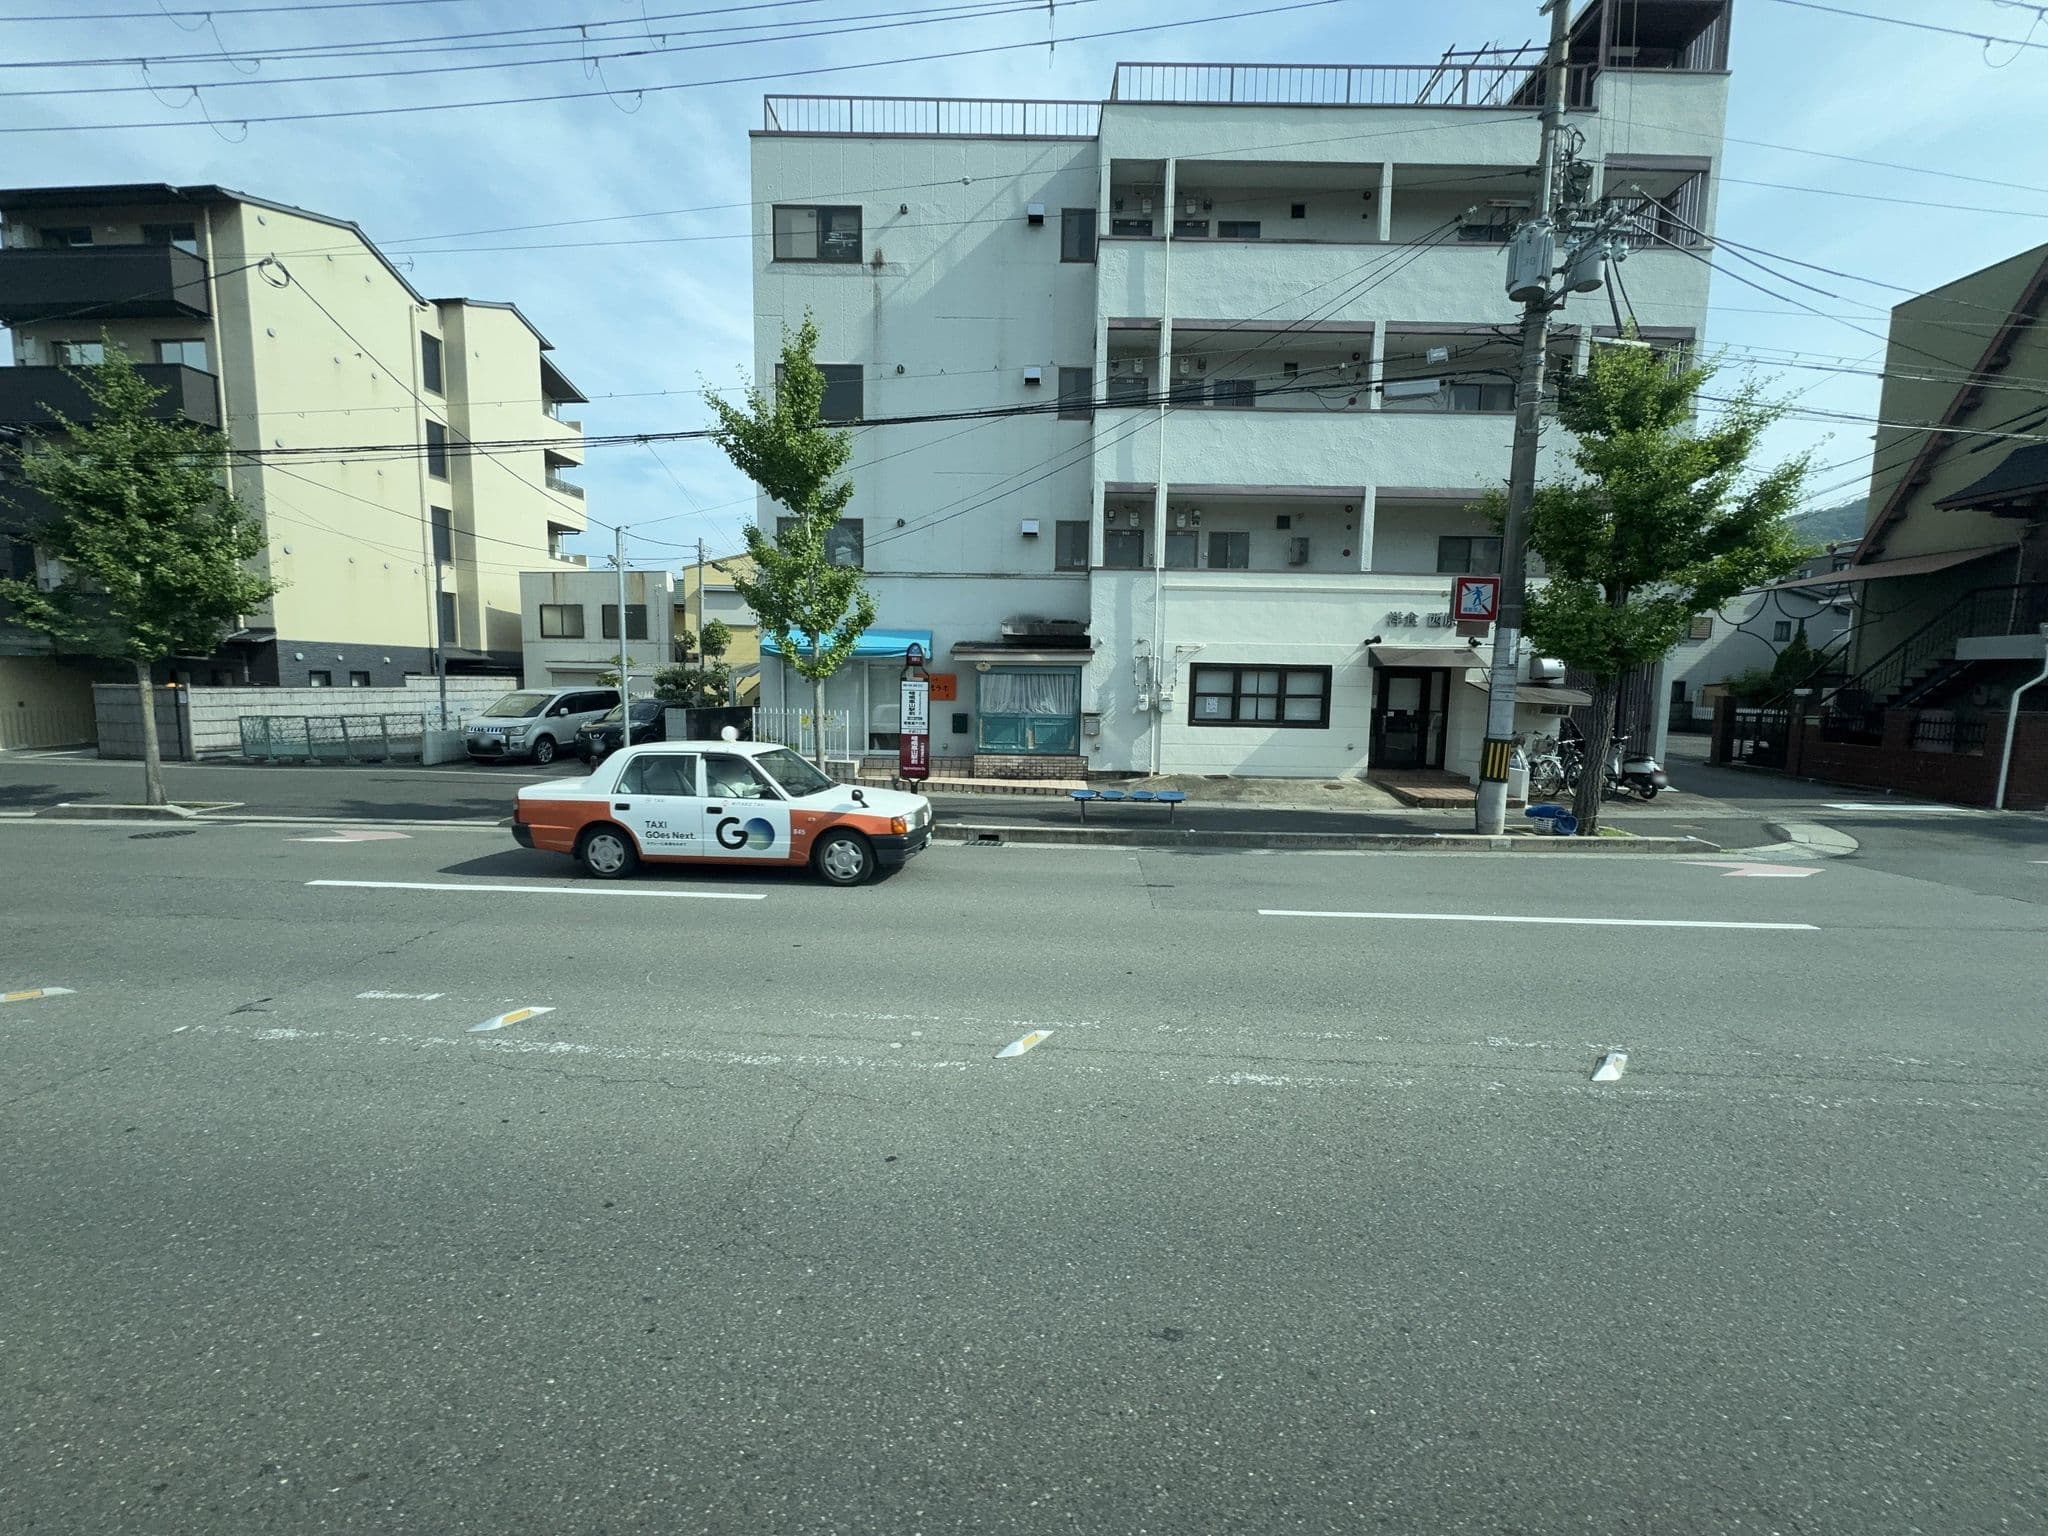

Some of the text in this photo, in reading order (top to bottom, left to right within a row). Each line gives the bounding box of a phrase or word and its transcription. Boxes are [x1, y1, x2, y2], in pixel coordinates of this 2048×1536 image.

[1386, 611, 1419, 627] 洋食
[645, 820, 667, 829] TAXI
[645, 830, 697, 840] GOes Next.
[716, 817, 775, 851] GO
